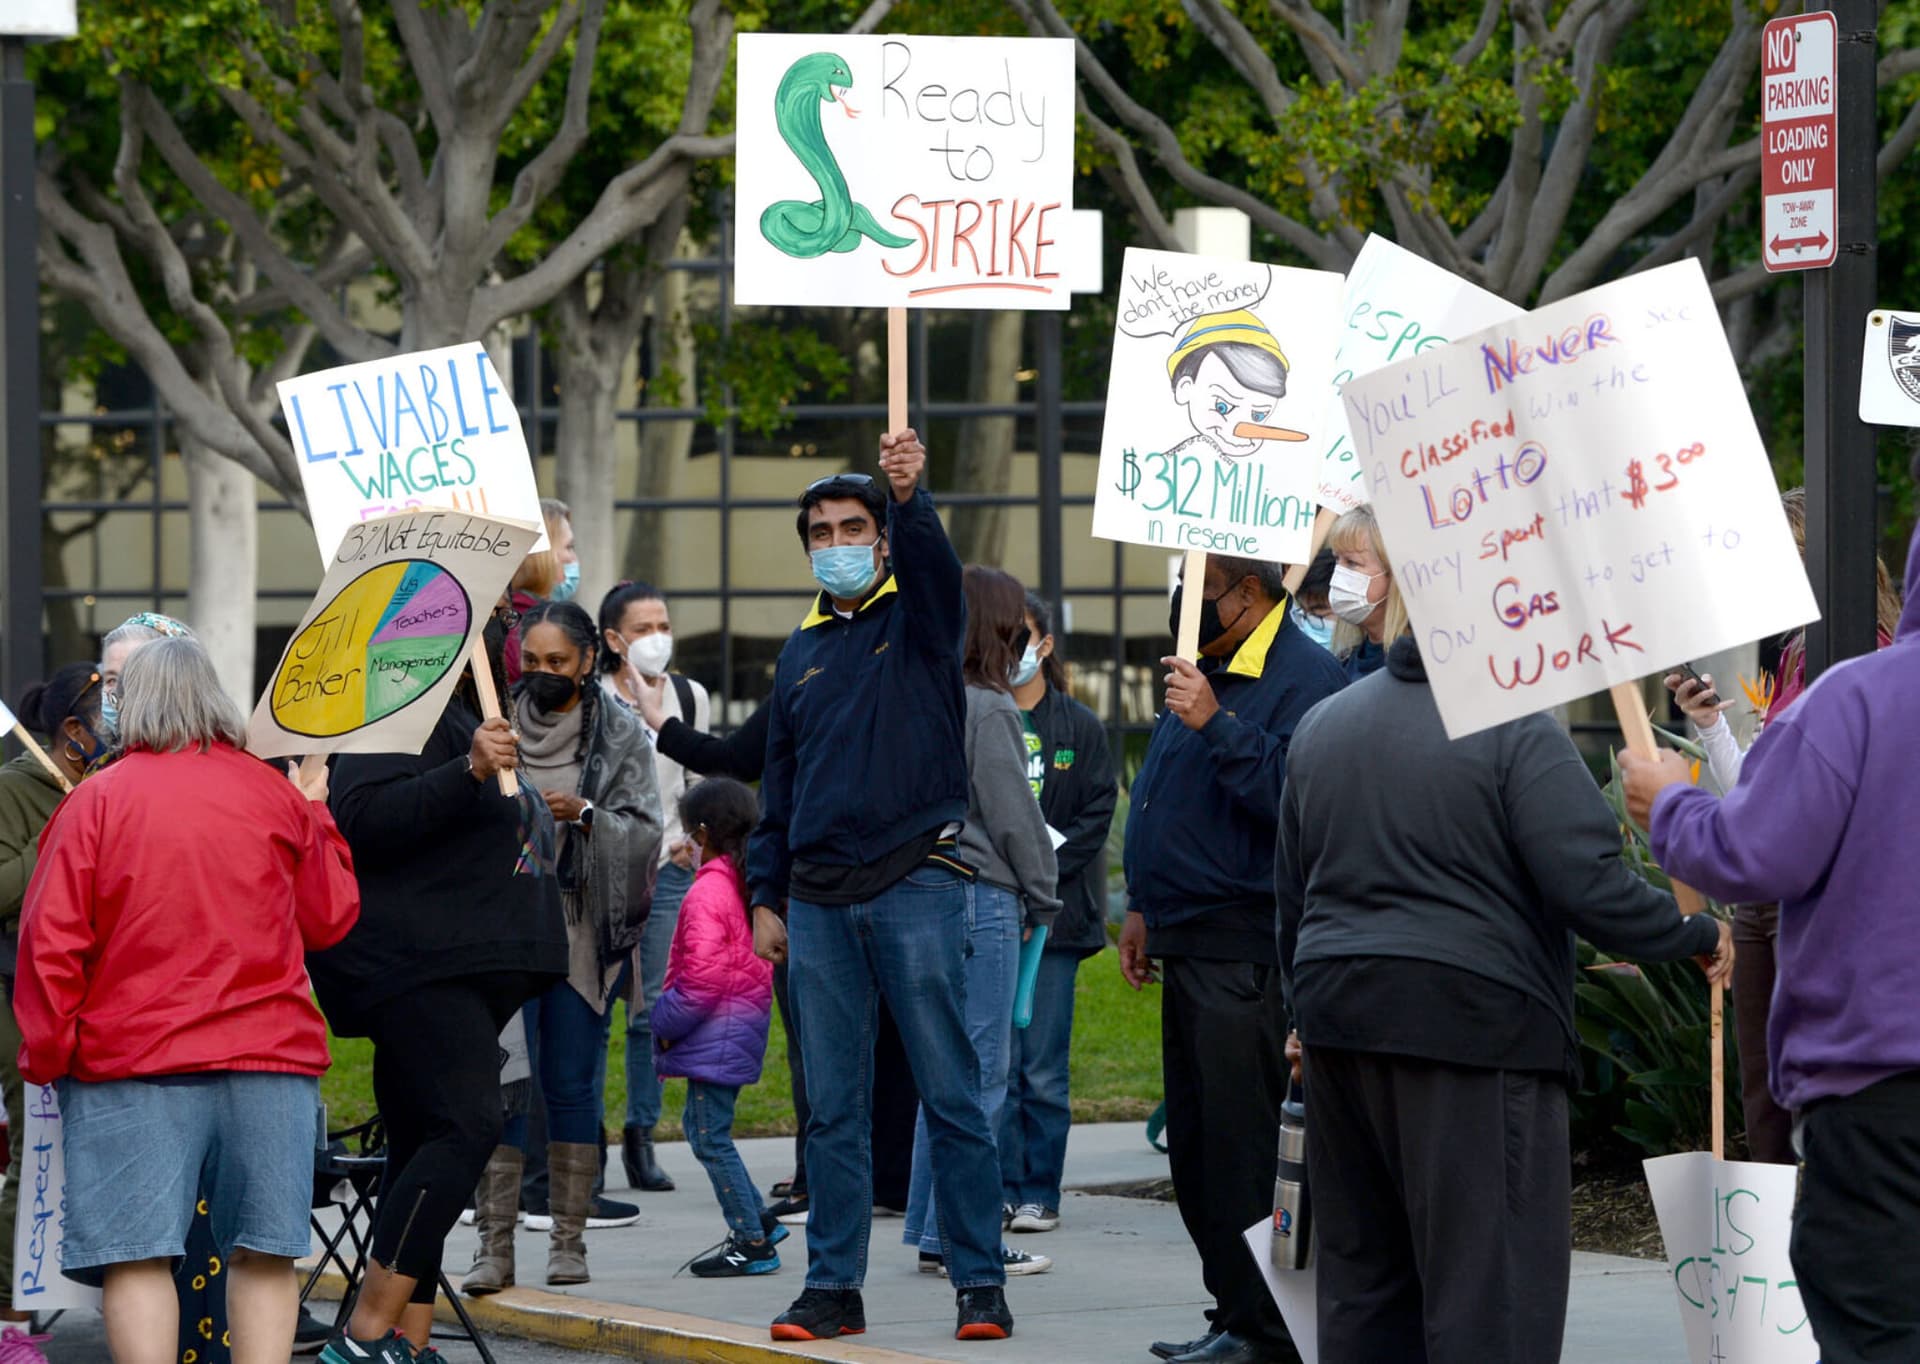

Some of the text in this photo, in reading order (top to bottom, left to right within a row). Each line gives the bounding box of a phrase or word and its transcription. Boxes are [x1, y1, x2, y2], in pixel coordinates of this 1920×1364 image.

[1767, 27, 1794, 69] NO
[882, 41, 1045, 163] Ready
[1768, 76, 1830, 111] PARKING
[929, 128, 995, 182] to
[1769, 124, 1828, 154] LOADING
[1781, 158, 1816, 184] ONLY
[1782, 199, 1816, 215] TOW-AWAY
[1790, 216, 1808, 229] ZONE
[881, 193, 1062, 280] STRIKE
[1130, 264, 1174, 294] We
[1170, 271, 1224, 303] have
[1168, 281, 1260, 326] the money
[290, 351, 510, 463] LIVABLE
[1371, 461, 1392, 497] A
[1590, 363, 1651, 393] the
[339, 437, 477, 500] WAGES
[1115, 447, 1203, 519] $312
[375, 517, 417, 555] Not
[416, 514, 512, 559] Equitable
[1177, 520, 1260, 555] reserve
[391, 602, 460, 631] Teachers
[1427, 623, 1476, 665] ON
[1583, 563, 1614, 590] to
[1630, 545, 1676, 584] get
[1702, 524, 1742, 551] to
[296, 607, 361, 660] Jill
[275, 660, 362, 711] Baker
[369, 651, 450, 684] Management
[20, 1135, 54, 1297] Respect
